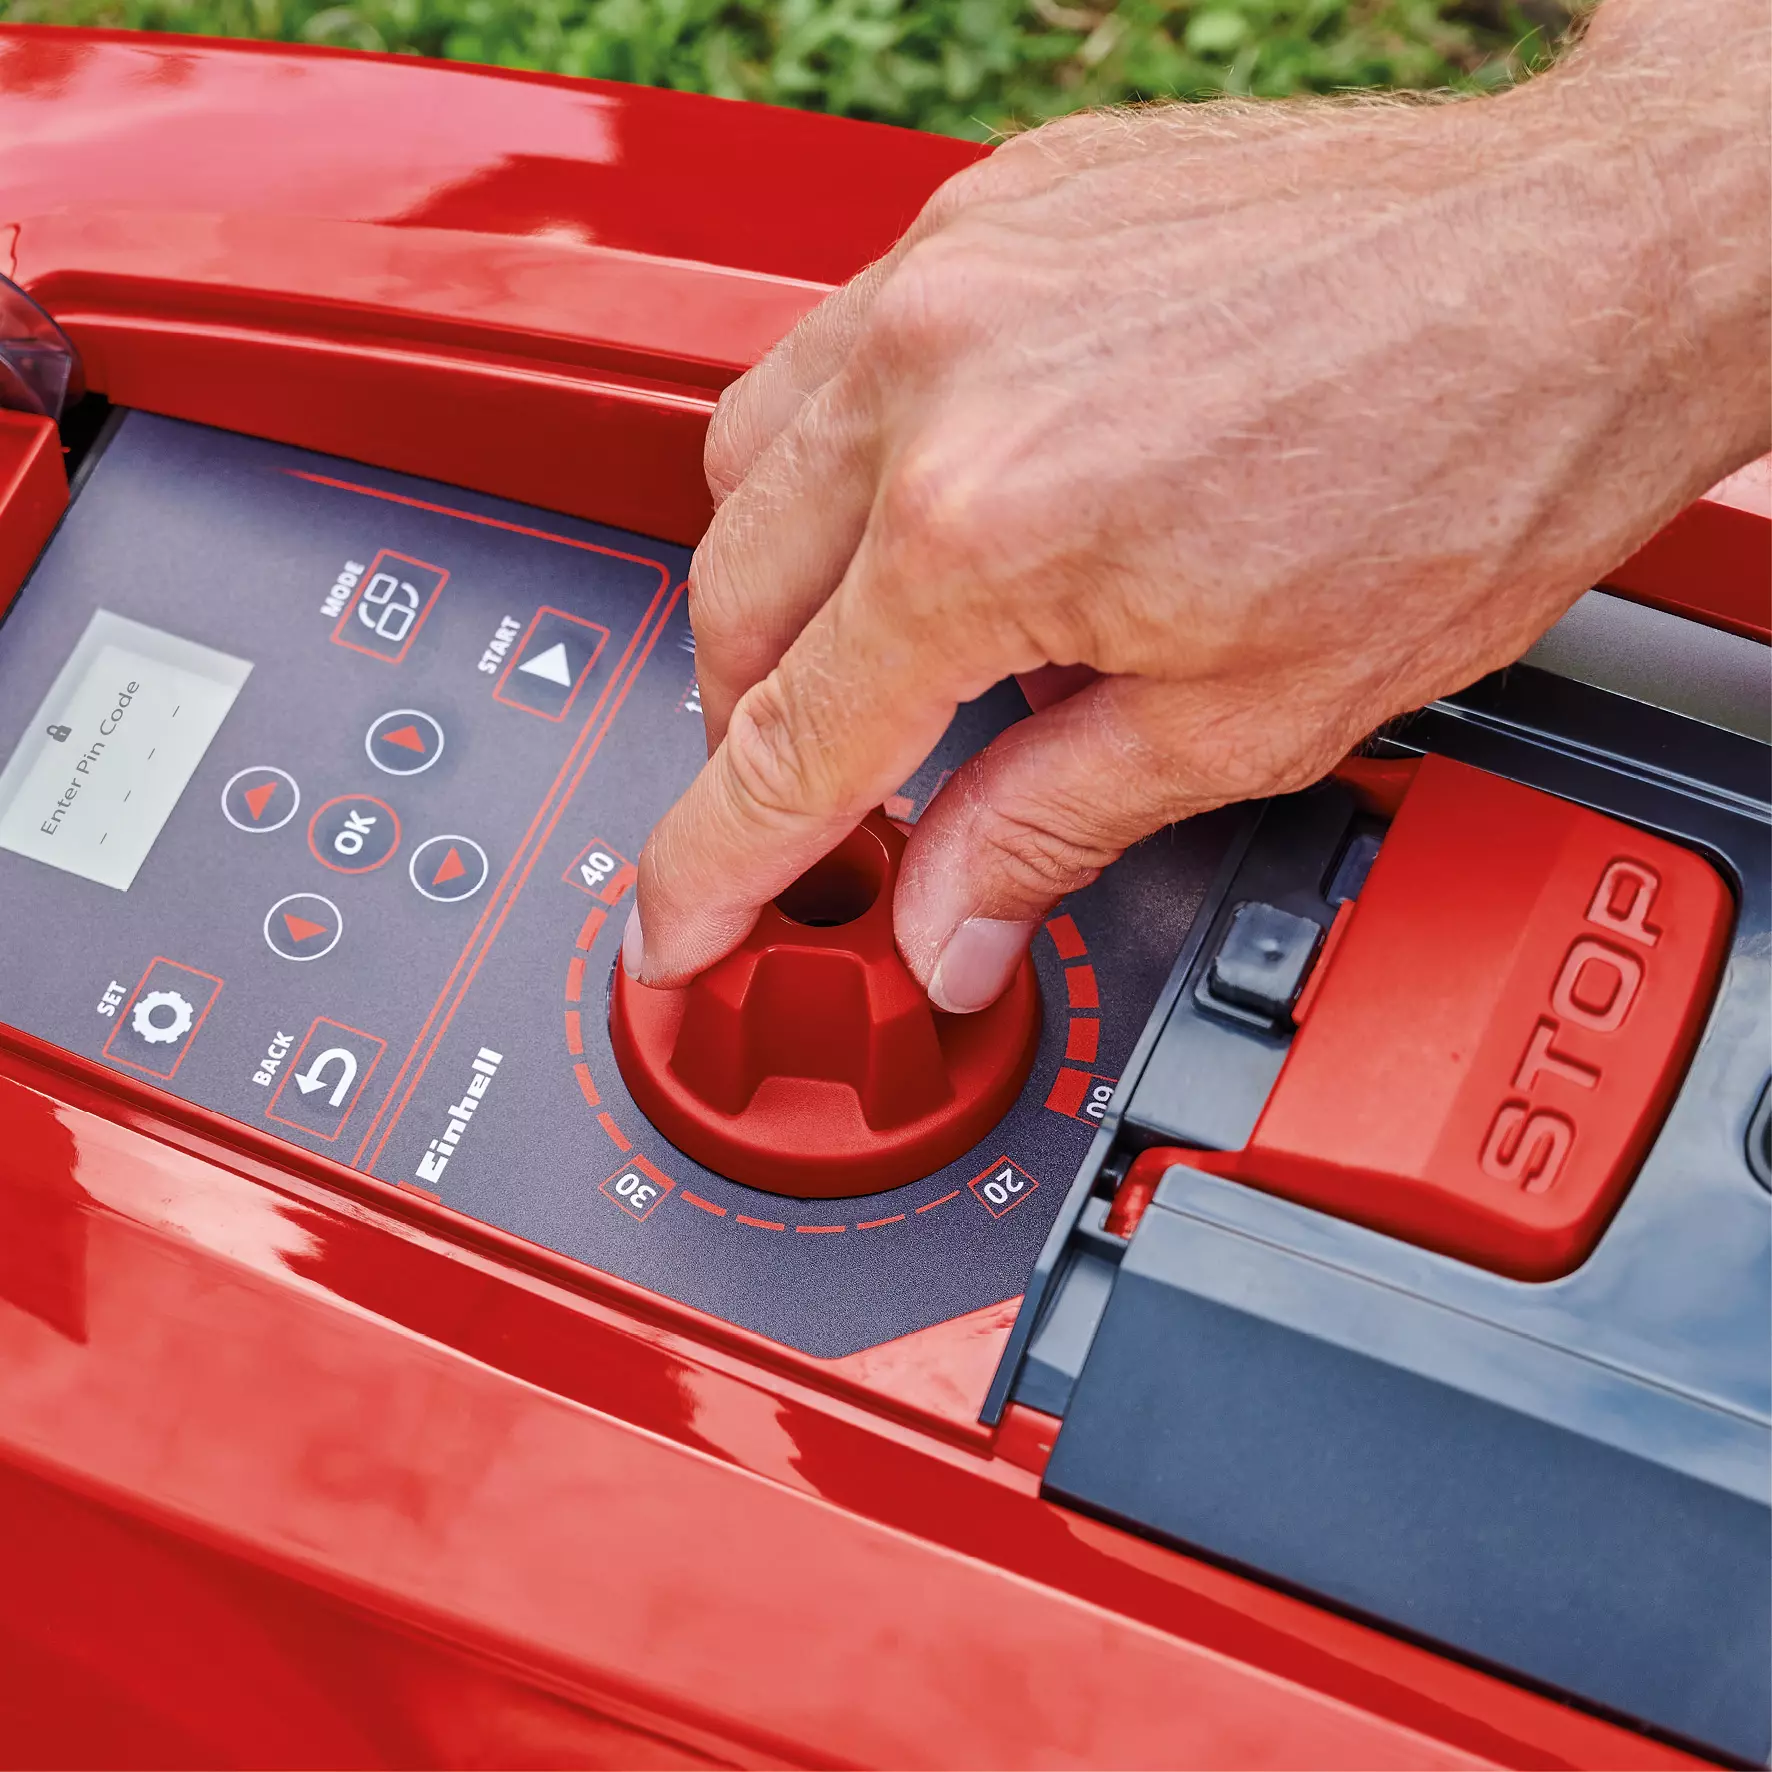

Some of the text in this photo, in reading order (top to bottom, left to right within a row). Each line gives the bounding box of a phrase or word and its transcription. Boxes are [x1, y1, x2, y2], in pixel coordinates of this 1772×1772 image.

[320, 560, 365, 618] MODE
[478, 615, 521, 675] START
[40, 680, 140, 835] Enter Pin Code
[333, 811, 377, 856] OK
[580, 852, 615, 886] 40
[97, 980, 127, 1017] SET
[1479, 855, 1664, 1195] STOP
[252, 1031, 295, 1087] BACK
[415, 1046, 503, 1183] Einhell
[615, 1172, 656, 1209] 30
[983, 1167, 1024, 1204] 20
